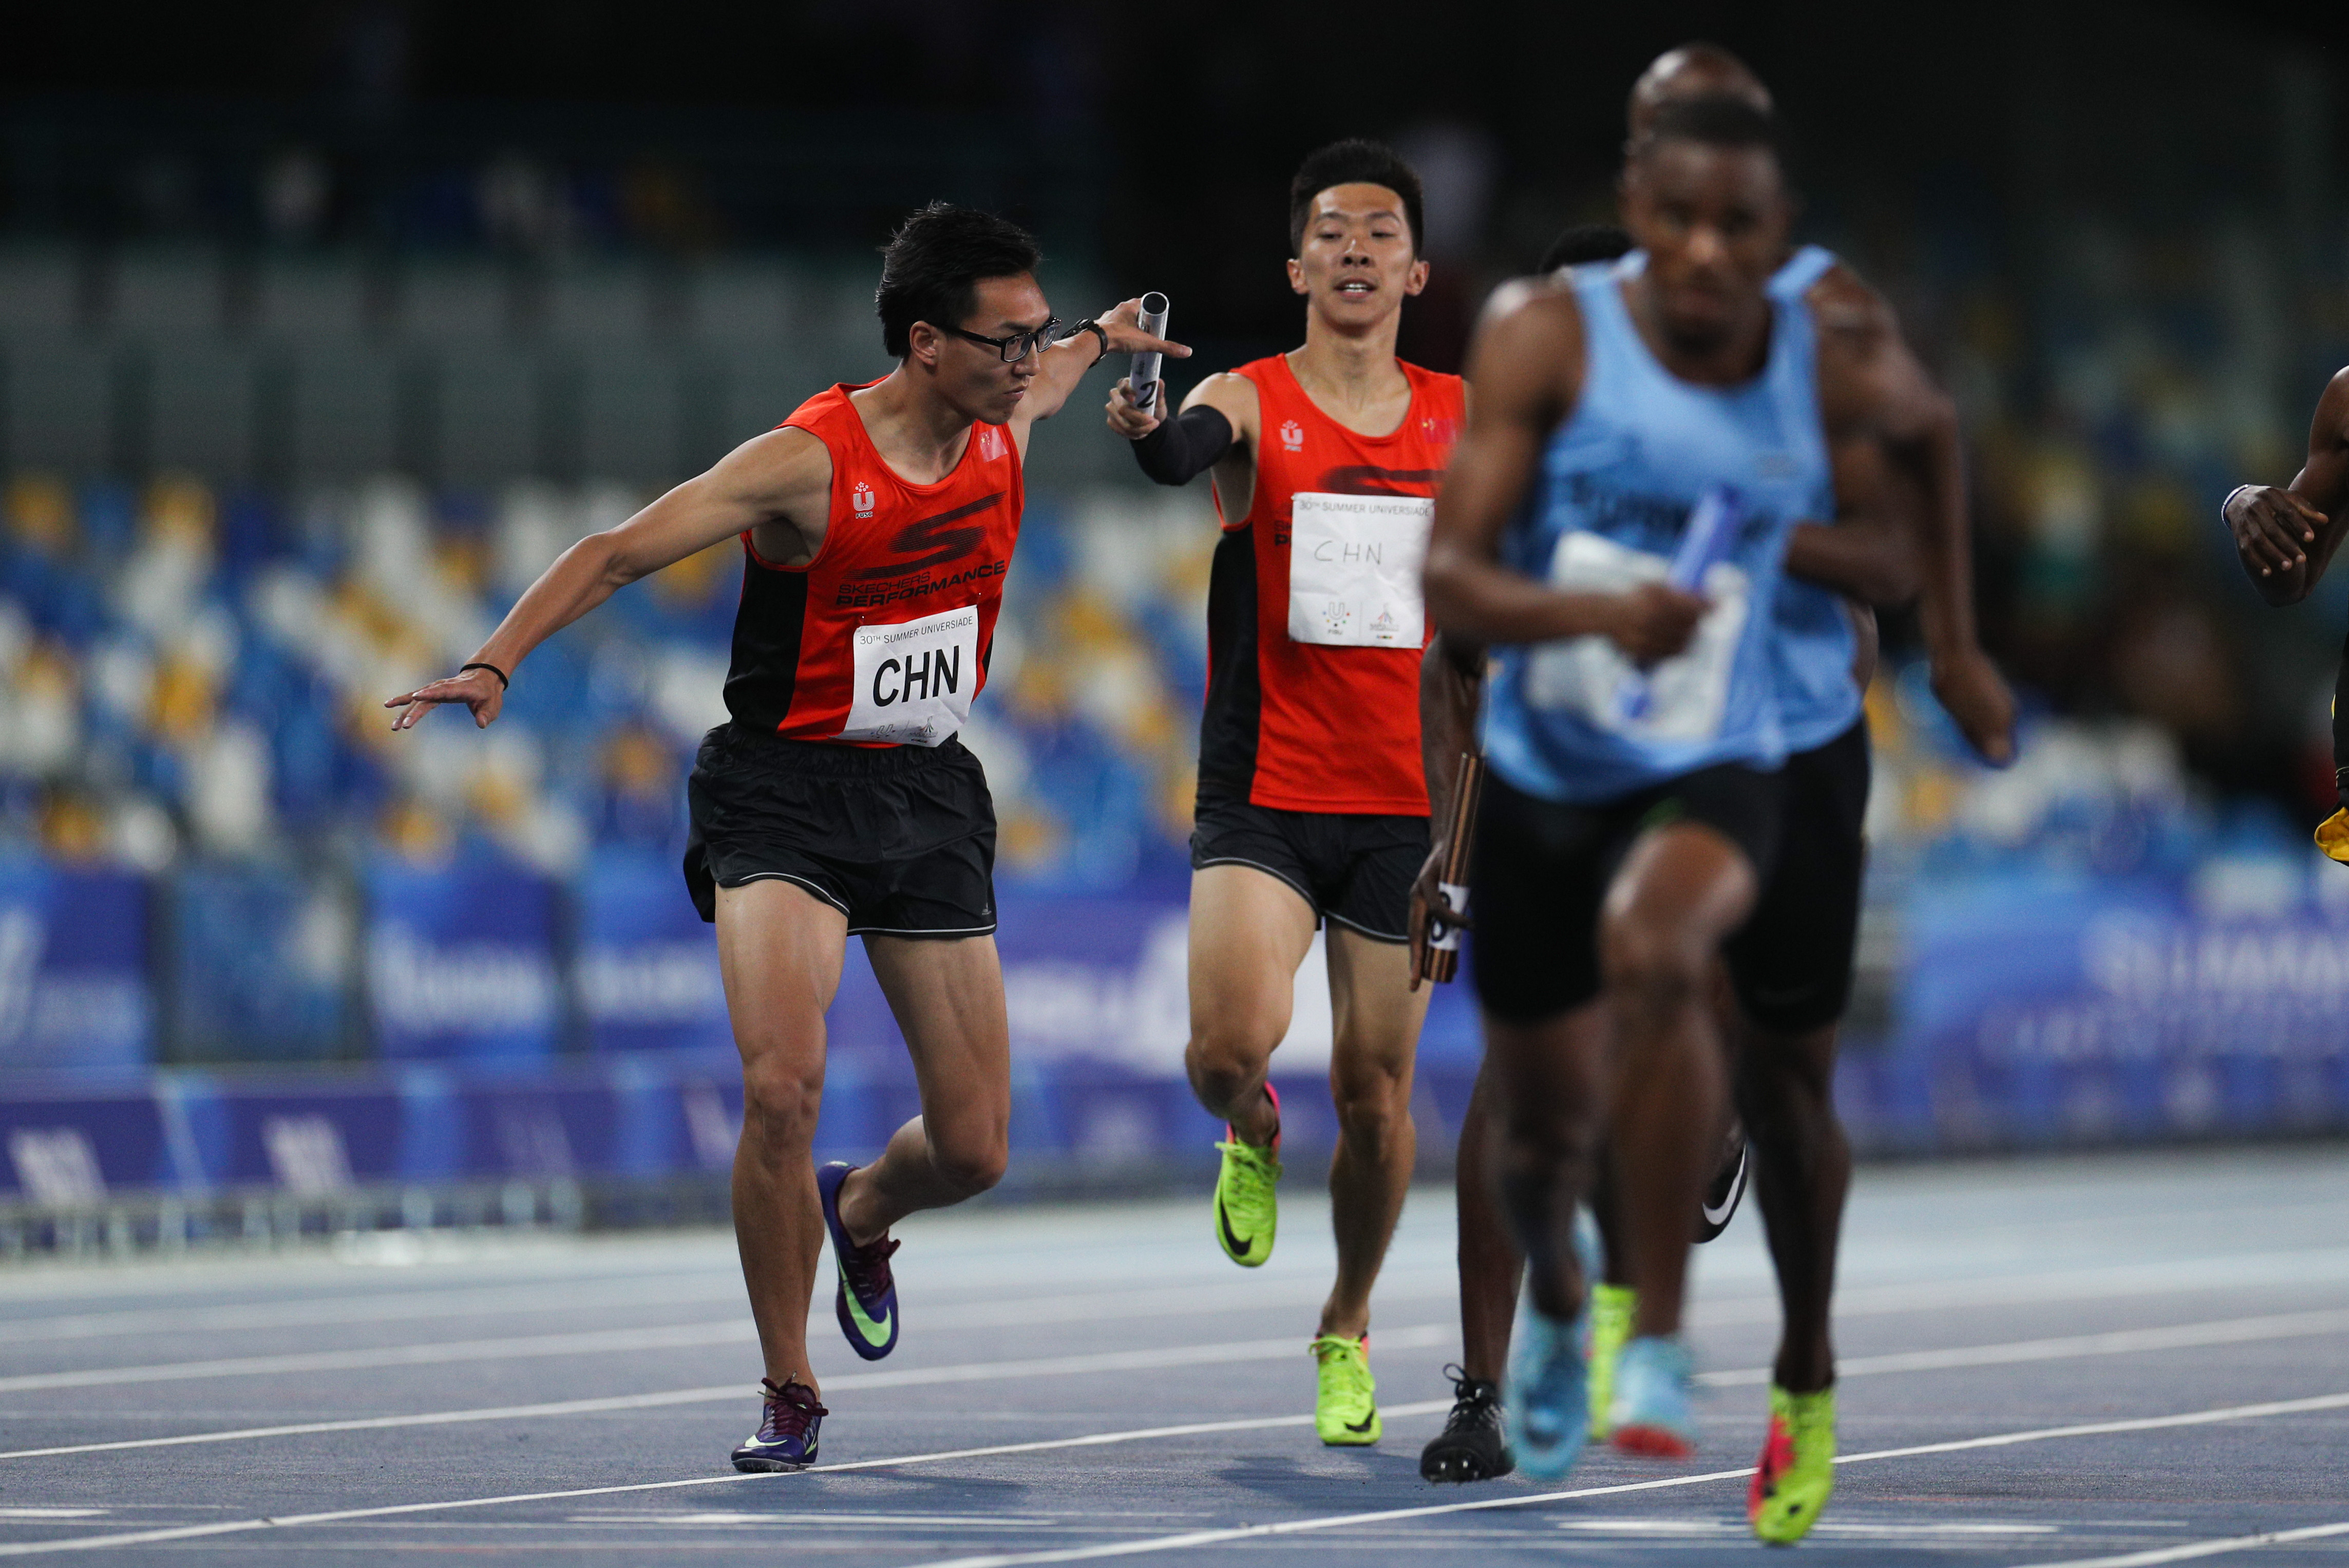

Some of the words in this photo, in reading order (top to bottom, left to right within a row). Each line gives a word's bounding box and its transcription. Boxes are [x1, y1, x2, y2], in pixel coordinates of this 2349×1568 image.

[1136, 380, 1157, 408] 2
[1322, 501, 1366, 513] SUMMER
[1369, 503, 1429, 517] UNIVERSIADE
[1314, 540, 1382, 565] CHN
[836, 560, 1006, 607] PERFORMANCE
[839, 571, 931, 594] SKECHERS
[860, 635, 881, 645] 30TH
[884, 628, 919, 644] SUMMER
[921, 616, 973, 635] UNIVERSIADE
[873, 645, 960, 707] CHN
